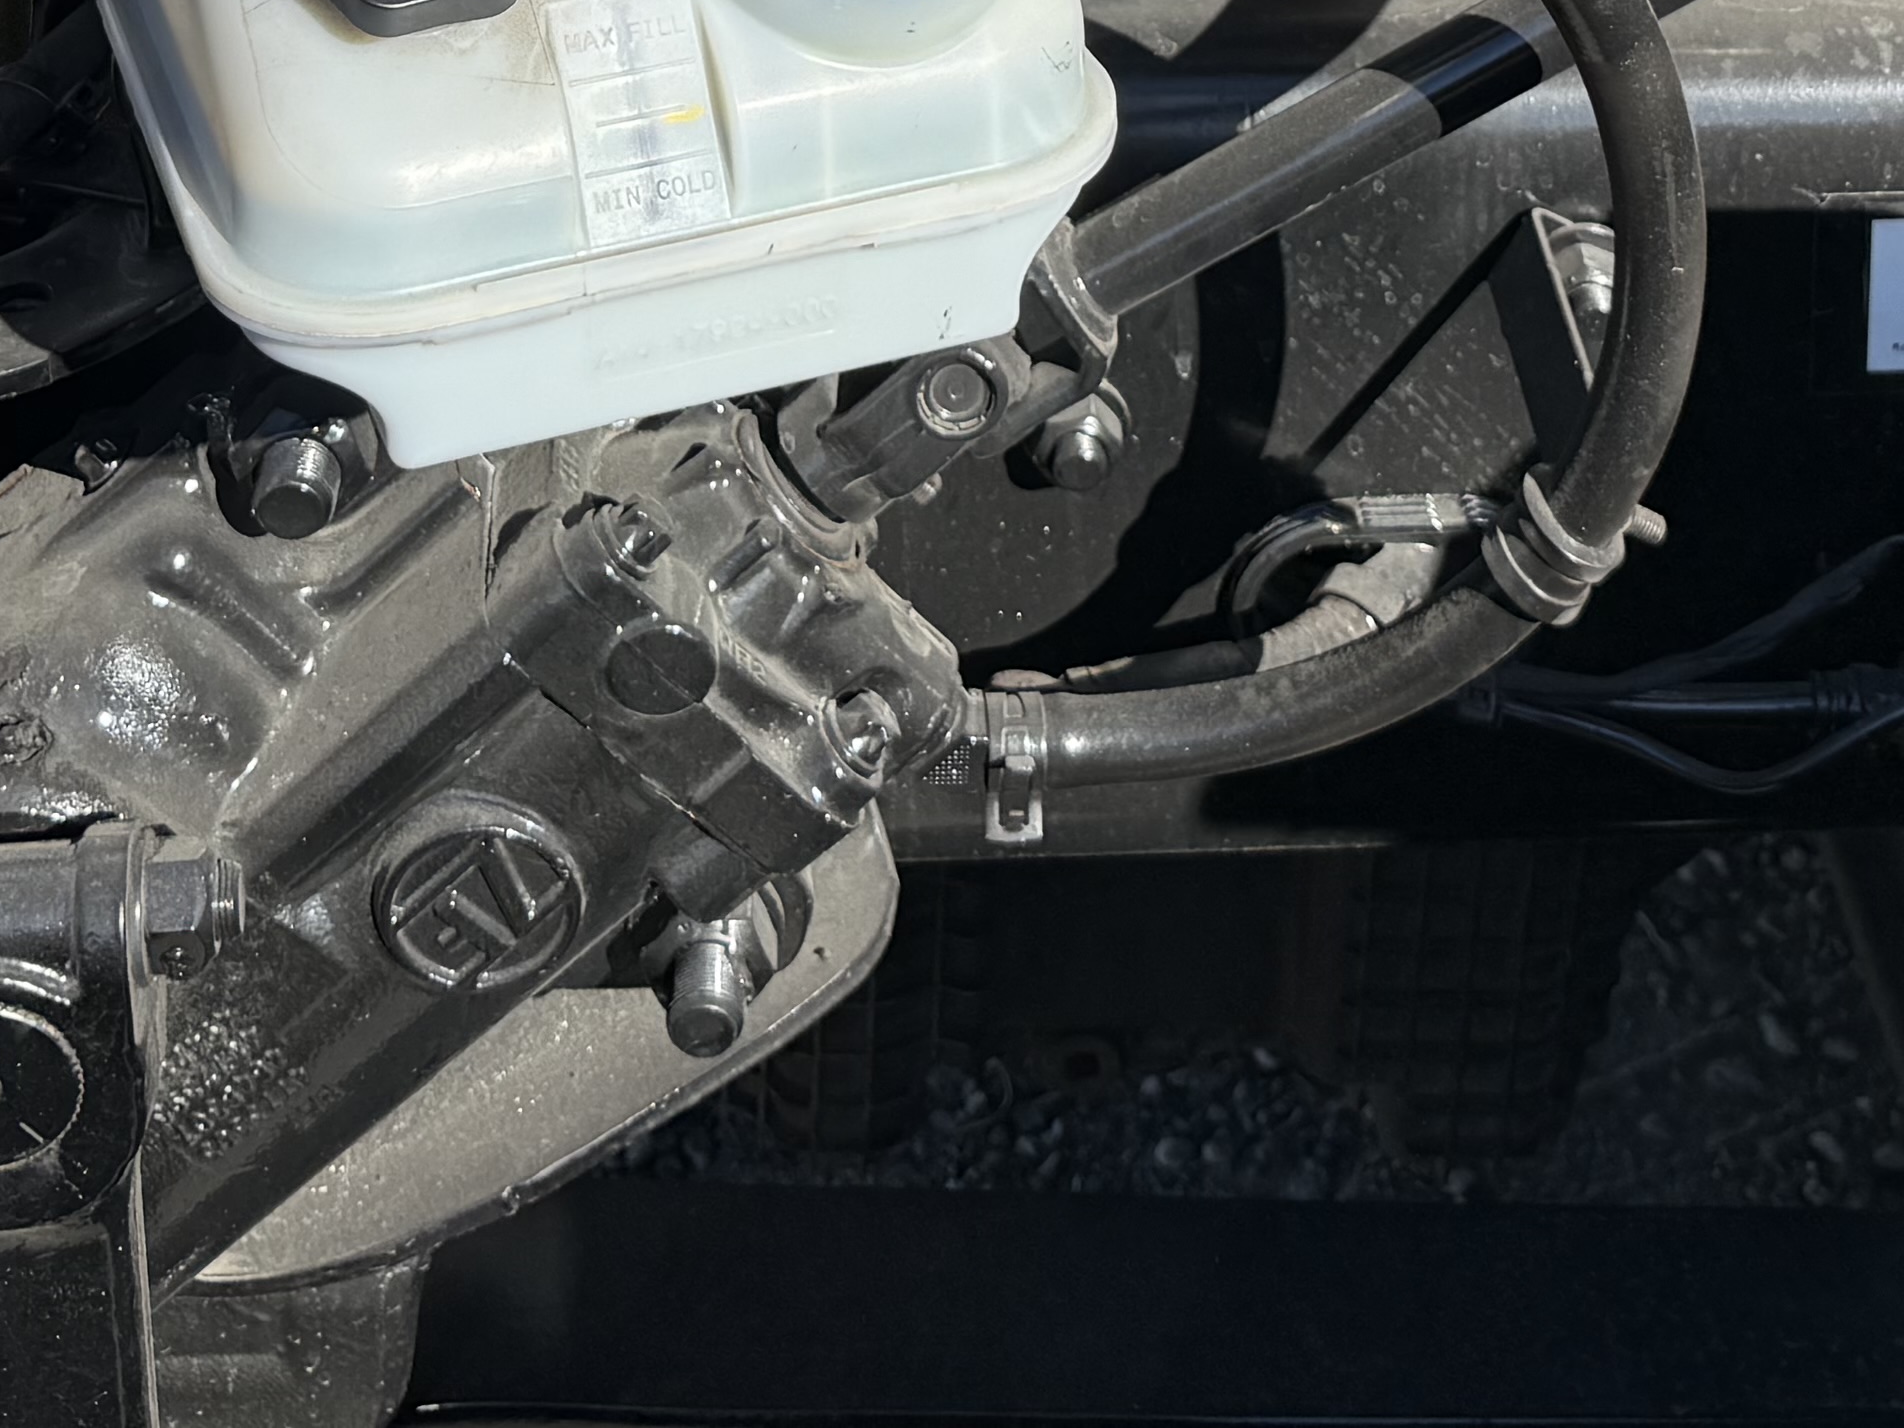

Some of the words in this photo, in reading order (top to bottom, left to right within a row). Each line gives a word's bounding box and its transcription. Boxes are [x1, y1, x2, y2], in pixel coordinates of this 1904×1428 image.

[563, 27, 615, 55] MAX
[628, 14, 689, 41] FILL
[595, 184, 642, 216] MIN
[656, 170, 719, 202] COLD
